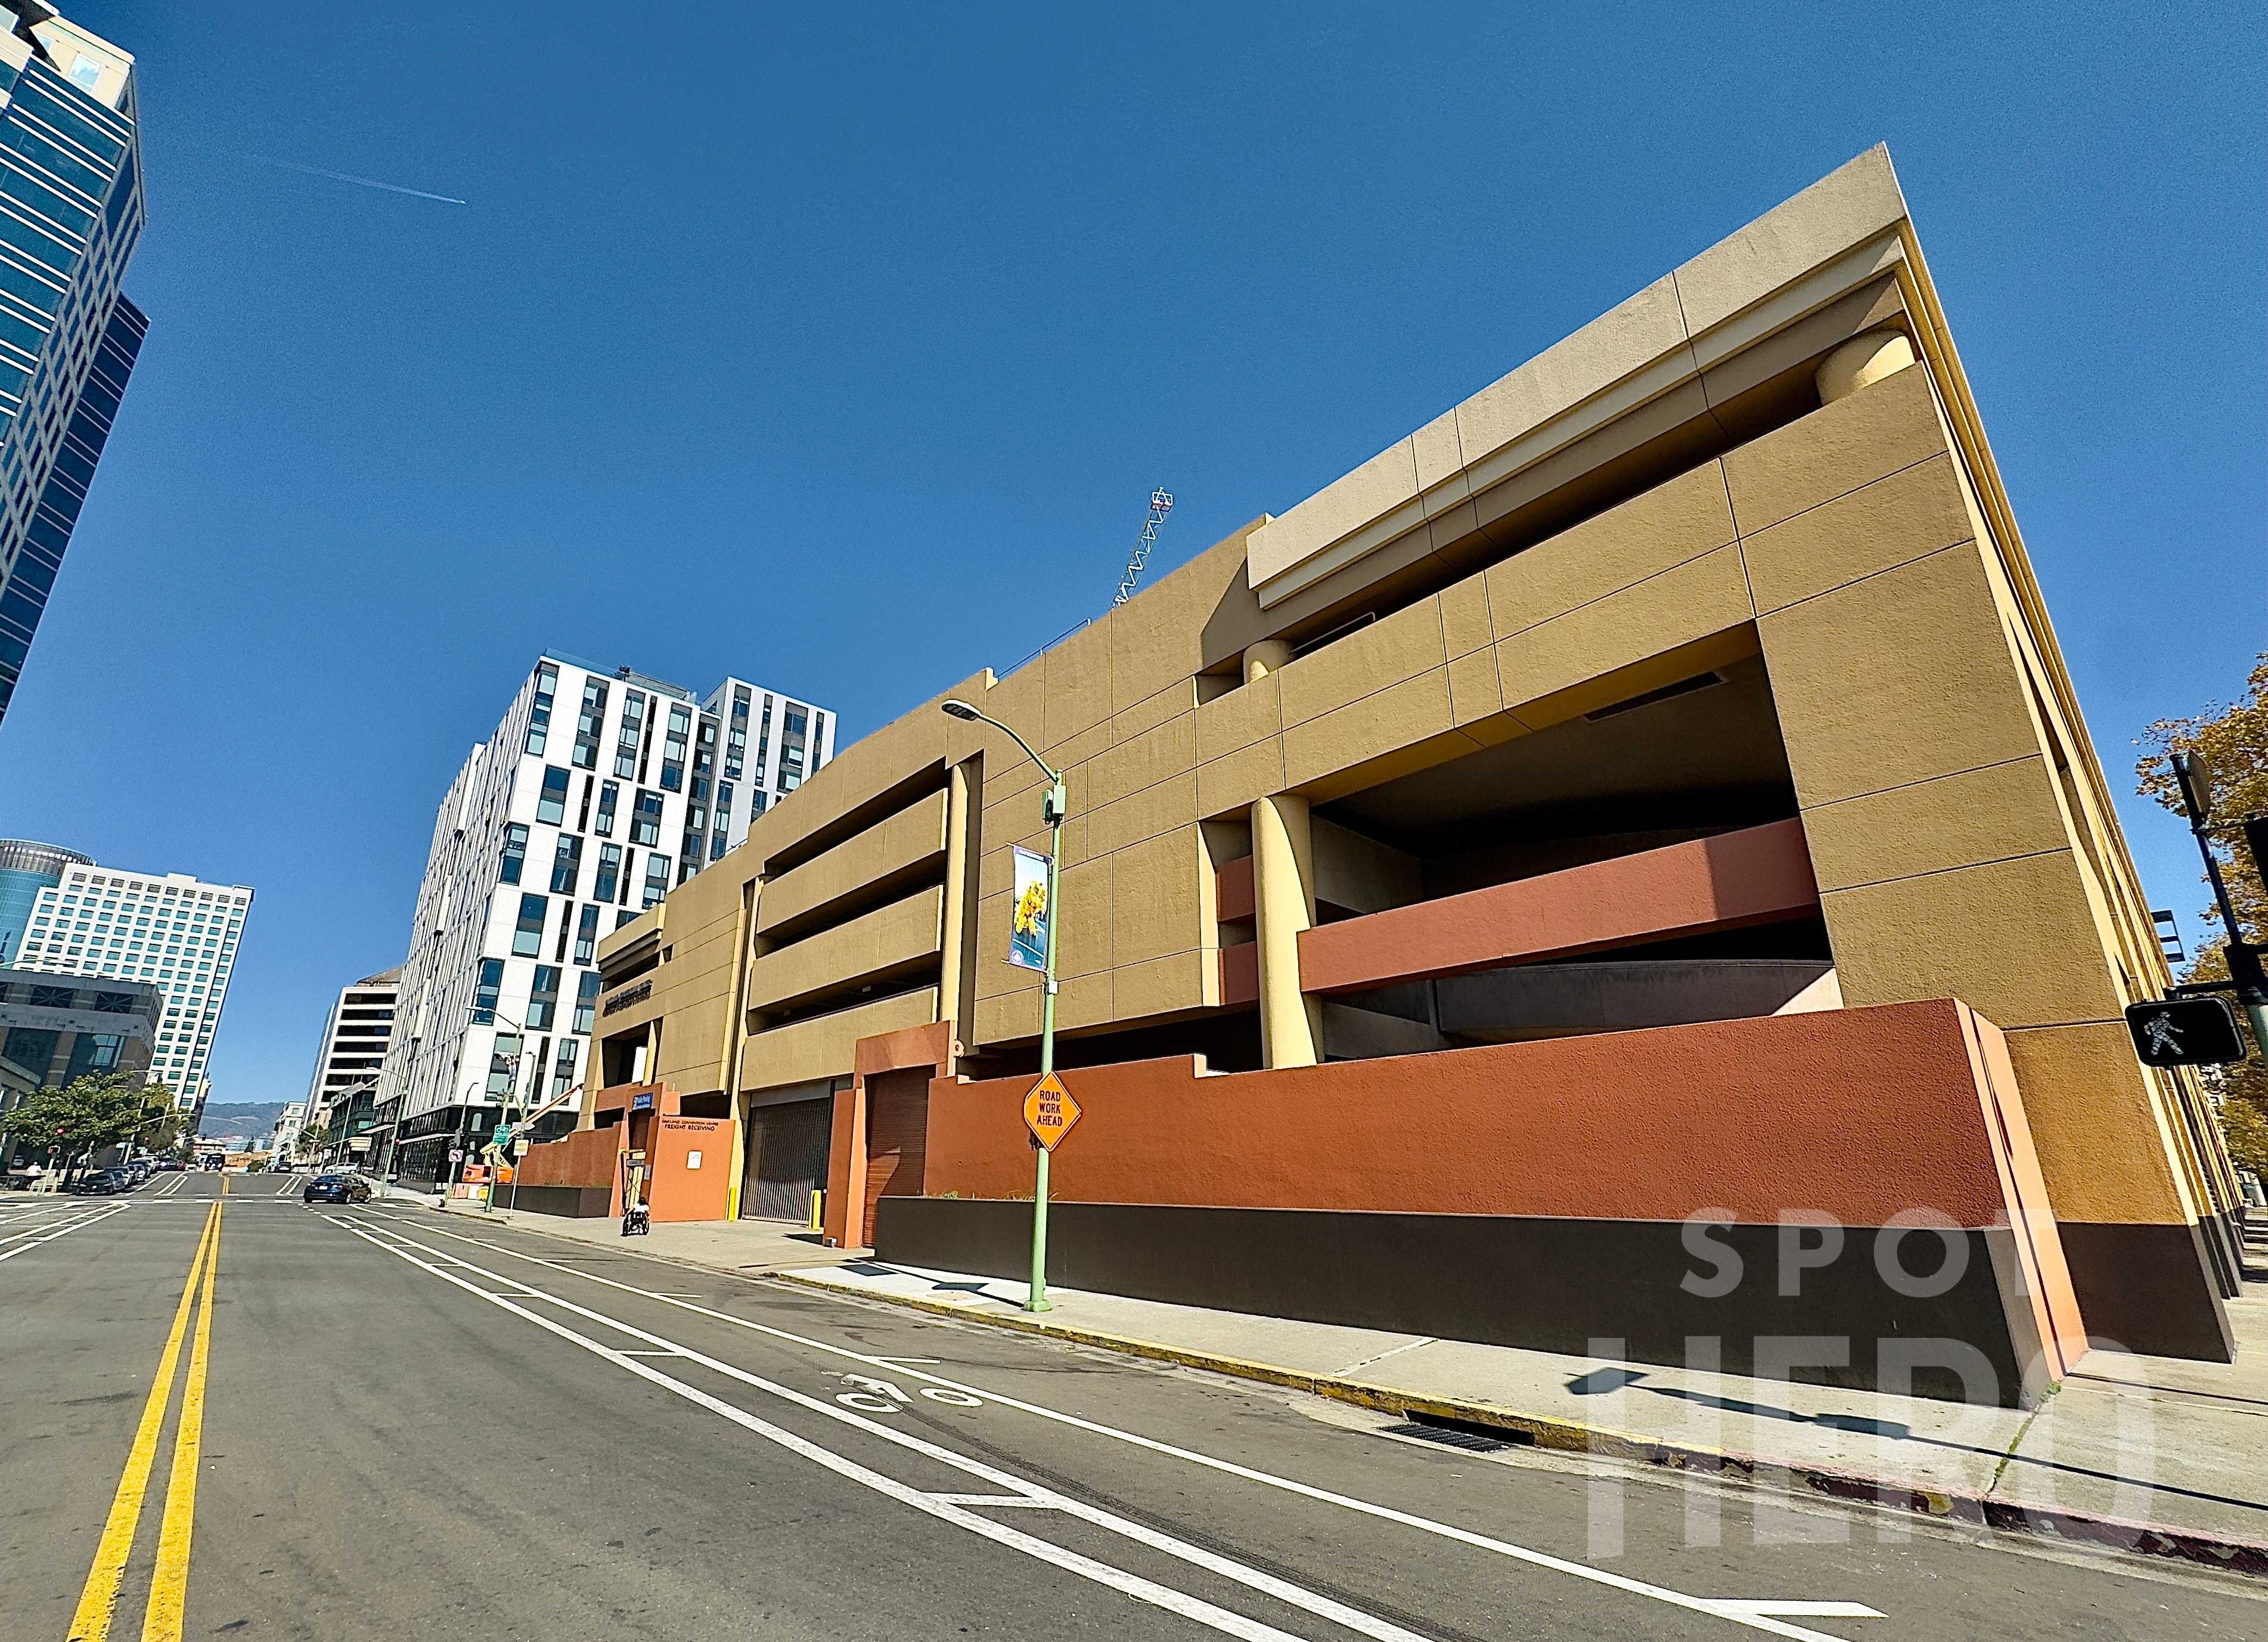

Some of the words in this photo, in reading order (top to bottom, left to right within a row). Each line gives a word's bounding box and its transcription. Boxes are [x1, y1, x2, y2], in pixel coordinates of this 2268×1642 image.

[1040, 1090, 1061, 1102] ROAD
[1039, 1102, 1061, 1114] WORK
[1037, 1115, 1063, 1127] AHEAD
